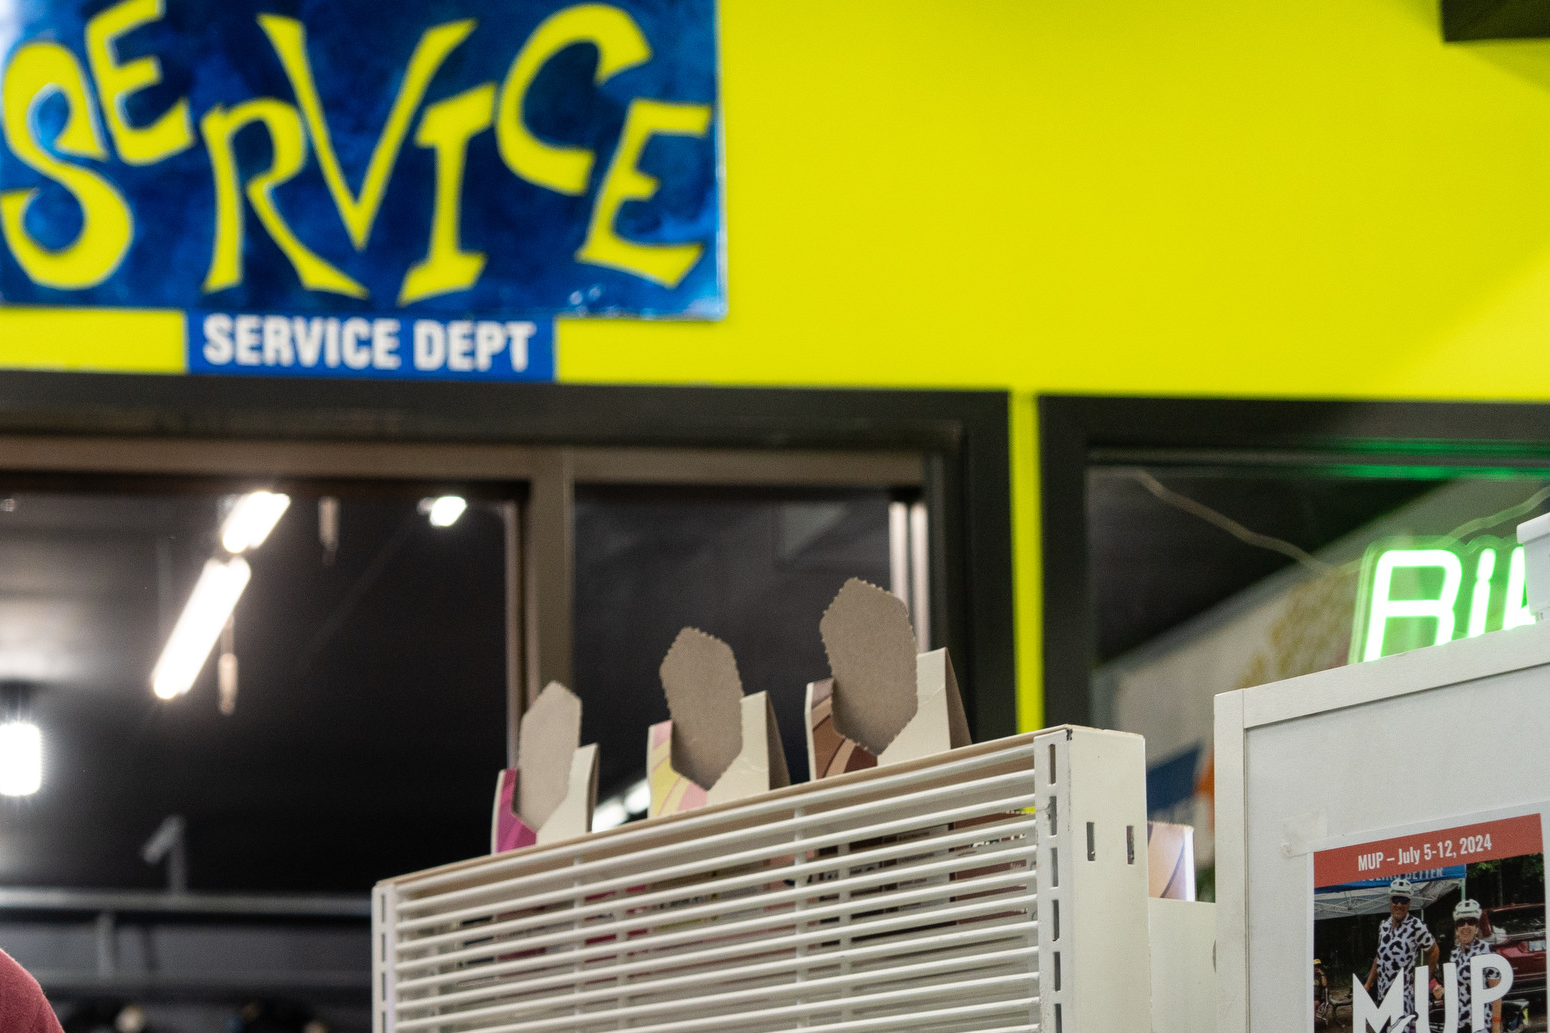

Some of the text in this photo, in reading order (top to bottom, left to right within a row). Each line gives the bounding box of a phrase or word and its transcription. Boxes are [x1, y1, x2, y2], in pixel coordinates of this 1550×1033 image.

[0, 0, 713, 304] SERVICE
[202, 313, 537, 372] SERVICE DEPT
[1358, 852, 1384, 872] MUP
[1398, 846, 1420, 865] July
[1424, 840, 1458, 860] 5-12,
[1459, 833, 1492, 855] 2024
